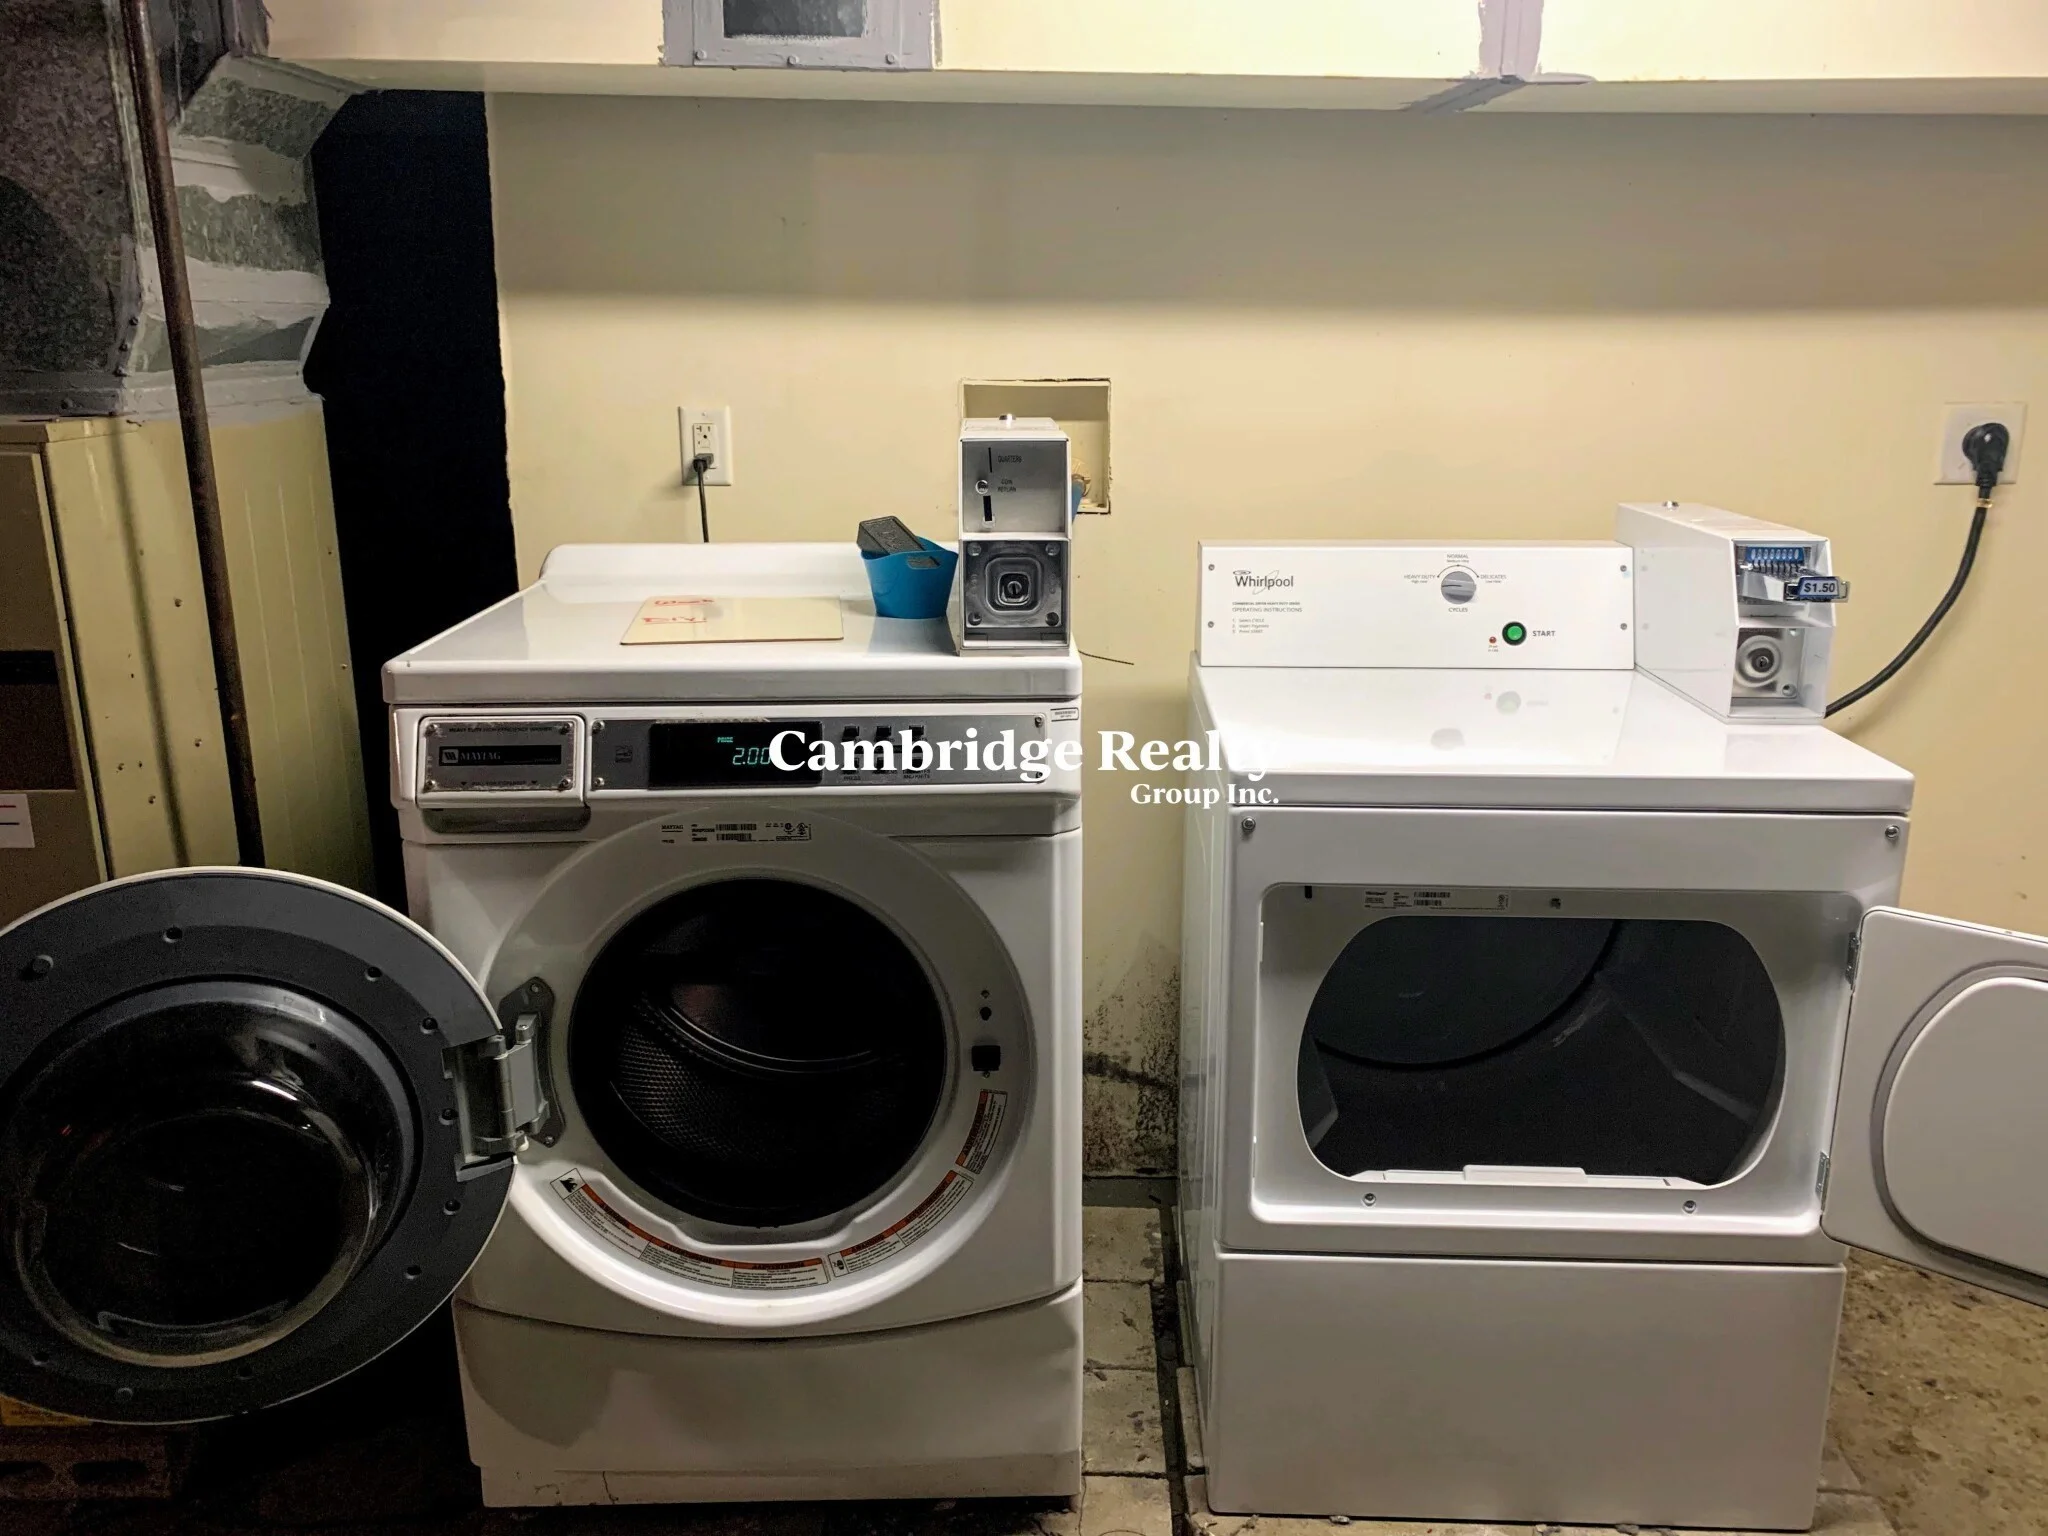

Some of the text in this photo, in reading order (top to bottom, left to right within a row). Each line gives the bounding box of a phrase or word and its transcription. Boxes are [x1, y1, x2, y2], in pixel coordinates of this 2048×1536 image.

[1235, 575, 1294, 590] Whirlpool
[1803, 582, 1836, 593] $1.50
[460, 751, 501, 760] MAYTAG
[732, 747, 771, 765] 2.00
